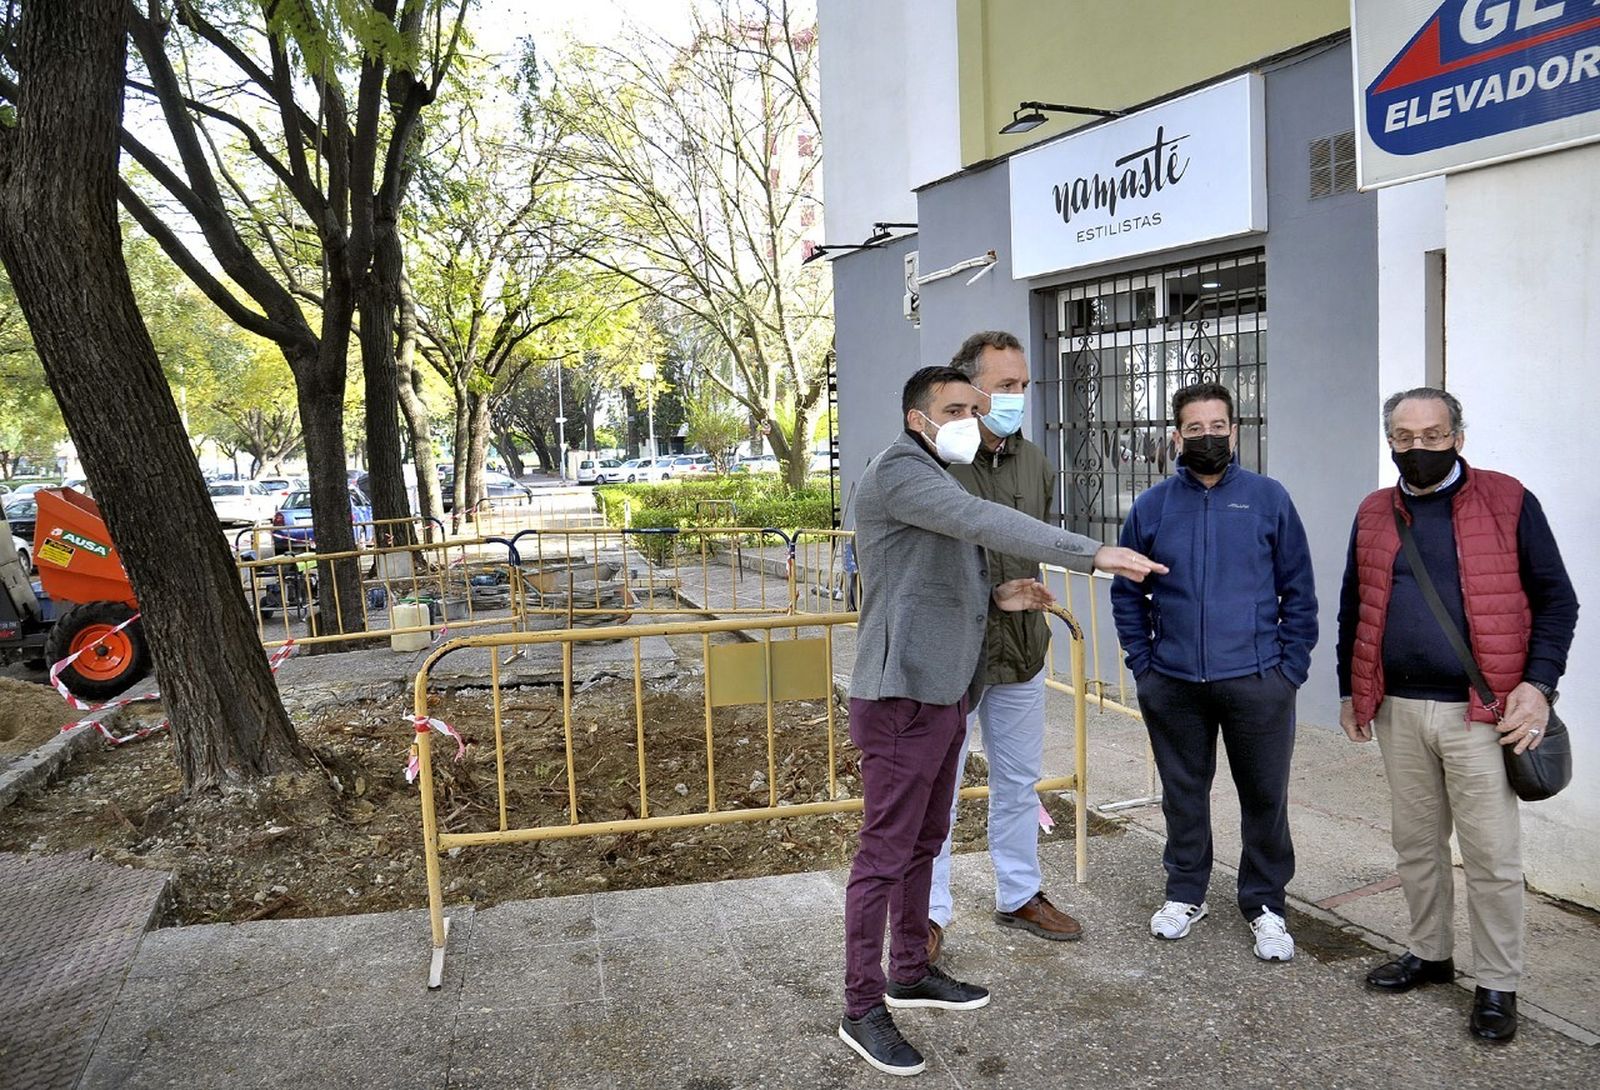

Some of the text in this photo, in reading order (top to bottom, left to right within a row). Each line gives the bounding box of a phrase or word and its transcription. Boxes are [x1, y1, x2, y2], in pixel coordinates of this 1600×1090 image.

[1384, 45, 1600, 134] ELEVADOR
[1076, 212, 1163, 243] ESTILISTAS
[62, 532, 107, 556] AUSA
